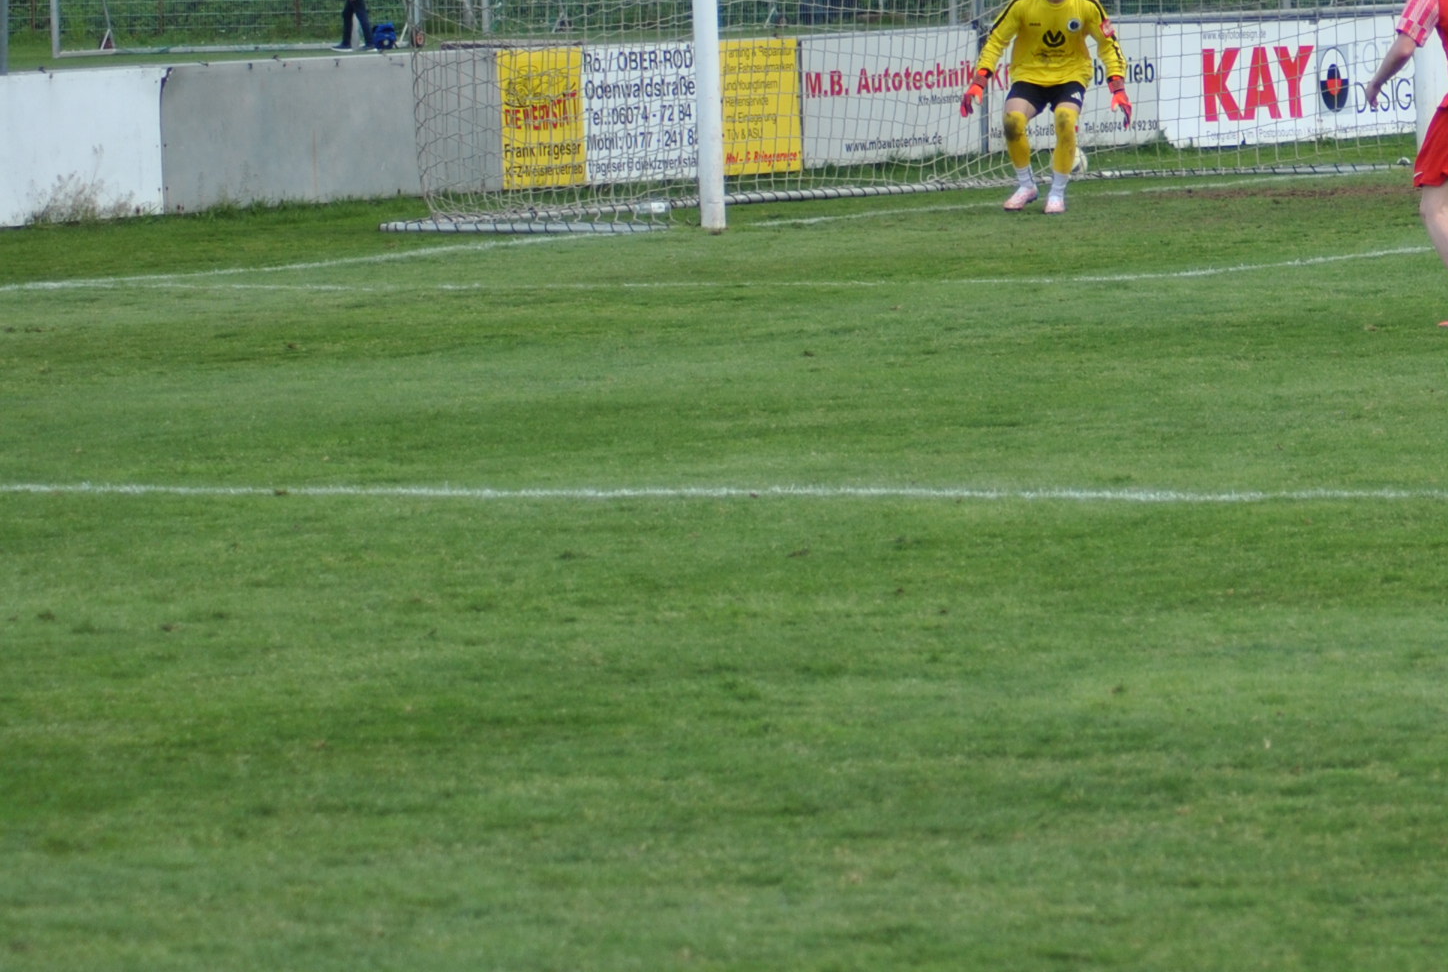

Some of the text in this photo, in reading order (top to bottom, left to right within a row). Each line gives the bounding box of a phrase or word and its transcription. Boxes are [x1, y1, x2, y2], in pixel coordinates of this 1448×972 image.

[616, 49, 694, 72] OBER-ROD
[585, 78, 696, 100] Odenwaldstraße
[805, 69, 849, 98] M.B.
[856, 60, 977, 94] Autotechnik
[1202, 45, 1315, 122] KAY
[918, 91, 964, 106] Kfz-Meisterbe
[504, 142, 581, 160] Frank Trageser
[586, 135, 624, 152] Mobil:
[845, 132, 943, 152] www.mbautotechnik.de
